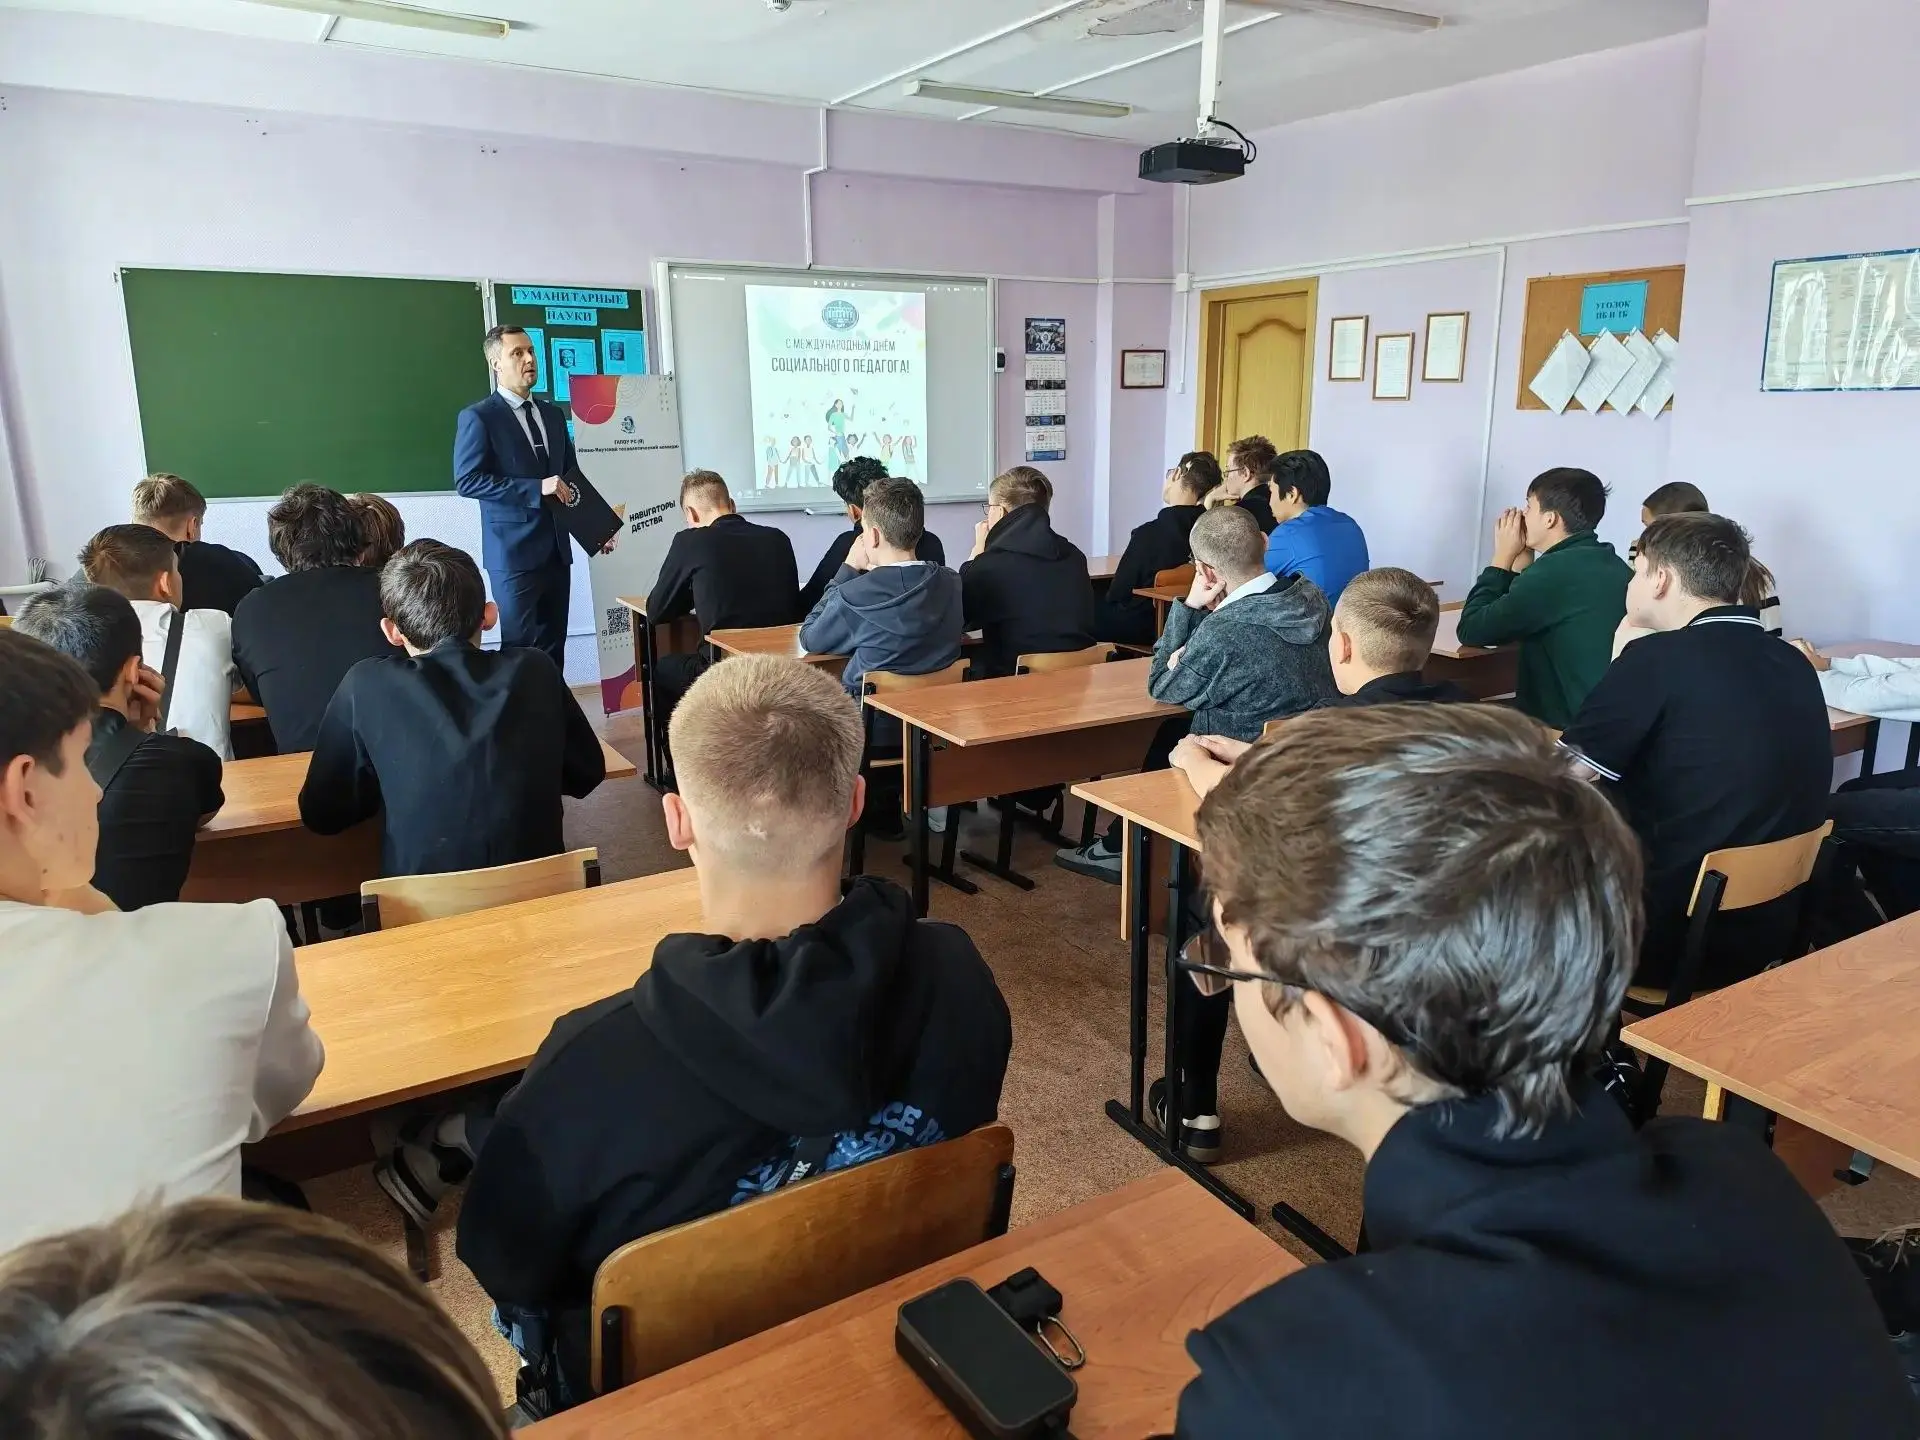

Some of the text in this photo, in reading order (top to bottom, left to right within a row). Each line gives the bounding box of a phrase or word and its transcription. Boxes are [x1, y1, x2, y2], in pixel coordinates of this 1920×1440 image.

[512, 288, 624, 305] ГУМАНИТАРНЫЕ
[1596, 300, 1631, 309] УГОЛОК
[547, 310, 593, 322] НАУКИ
[785, 337, 896, 352] С МЕЖДУНАРОДНЫМ ДНЁМ
[1035, 342, 1056, 351] 2026
[771, 356, 910, 374] СОЦИАЛЬНОГО ПЕДАГОГА!
[629, 500, 676, 522] НАВИГАТОРЫ
[631, 515, 664, 534] ДЕТСТВА
